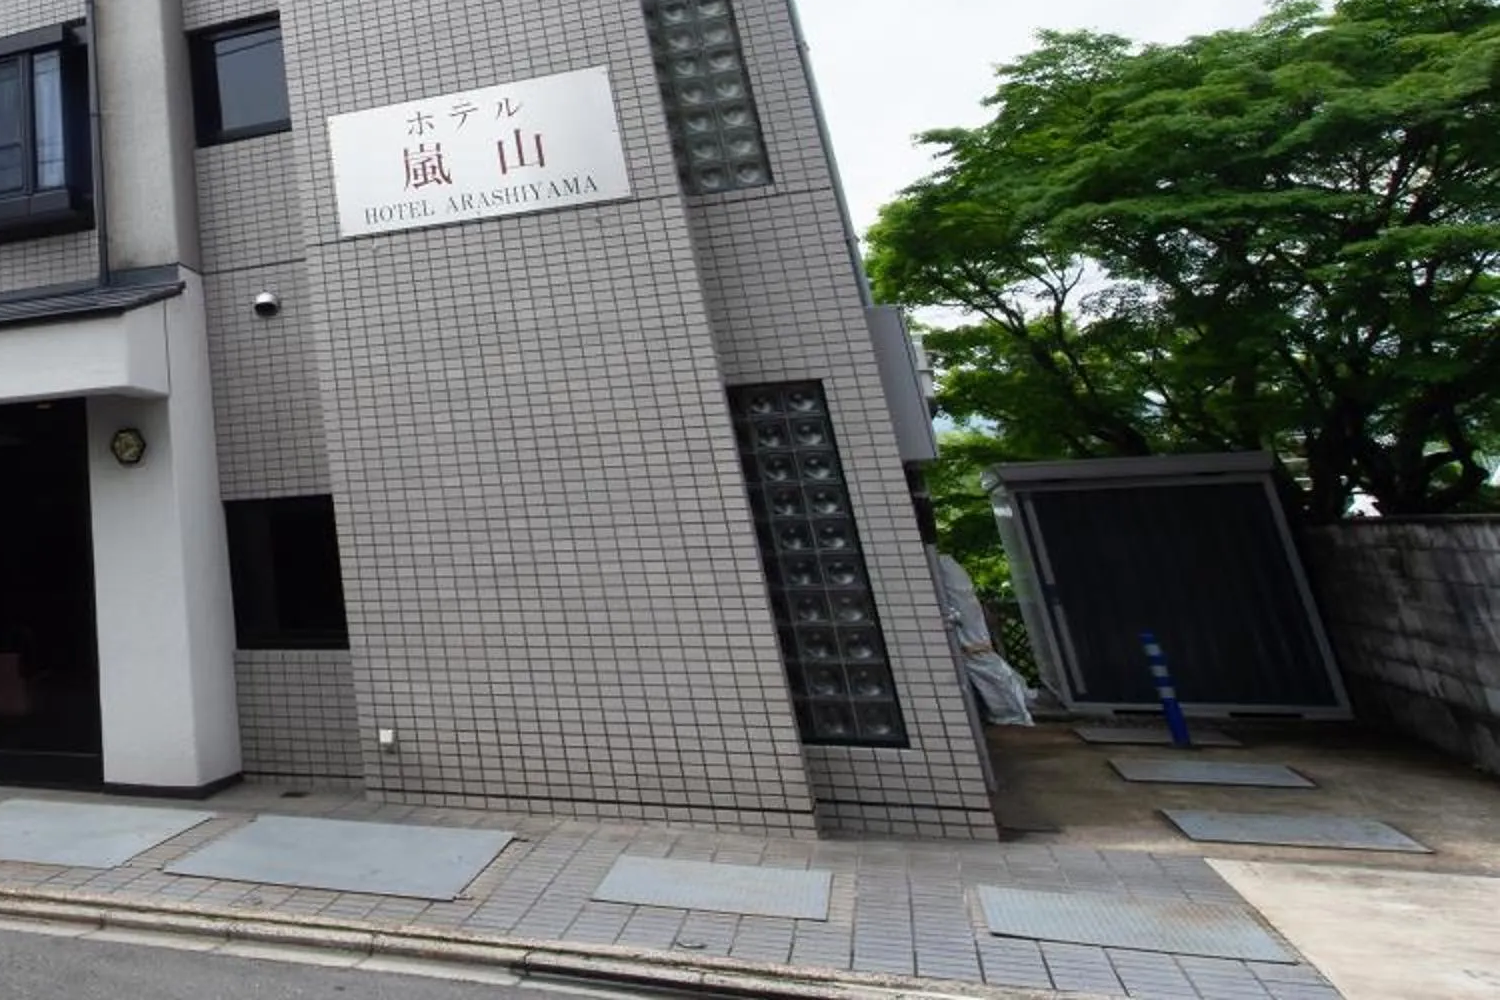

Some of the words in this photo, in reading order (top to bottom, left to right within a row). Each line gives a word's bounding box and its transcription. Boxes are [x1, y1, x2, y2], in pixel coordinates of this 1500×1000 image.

[407, 97, 522, 136] ホテル
[403, 128, 547, 192] 嵐山
[364, 198, 435, 226] HOTEL
[447, 174, 598, 214] ARASHIYAMA
